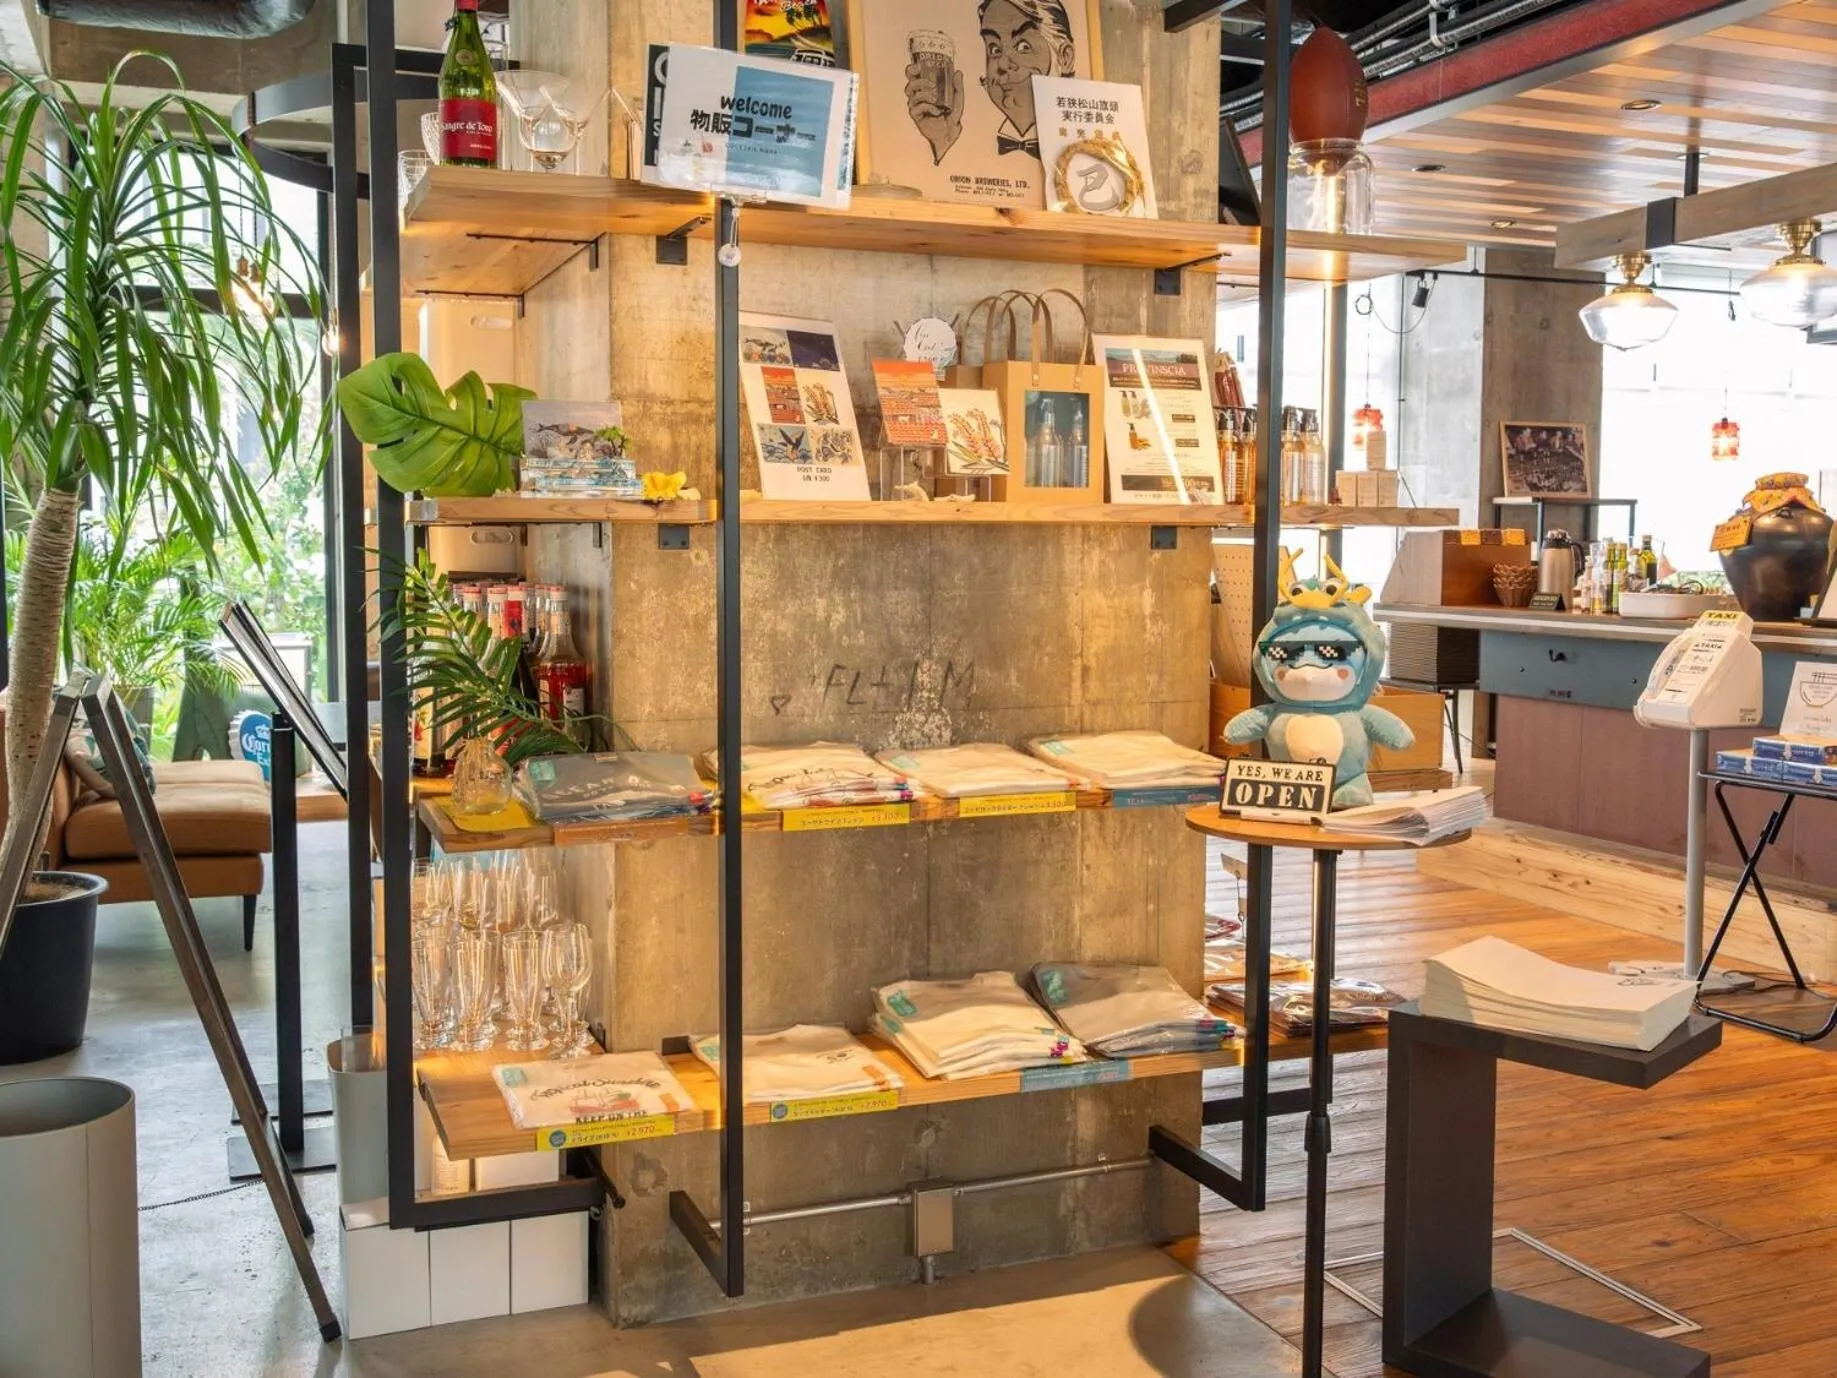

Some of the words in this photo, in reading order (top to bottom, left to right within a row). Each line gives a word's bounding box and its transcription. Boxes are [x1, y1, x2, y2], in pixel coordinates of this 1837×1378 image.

[720, 95, 793, 120] welcome
[1062, 110, 1115, 124] 実行委員会
[690, 108, 816, 144] 物販コーナー
[1015, 179, 1031, 189] LTD.
[1706, 612, 1738, 620] TAXI
[1237, 765, 1266, 779] YES,
[1271, 767, 1293, 780] WE
[1294, 770, 1324, 782] ARE
[1235, 782, 1318, 809] OPEN
